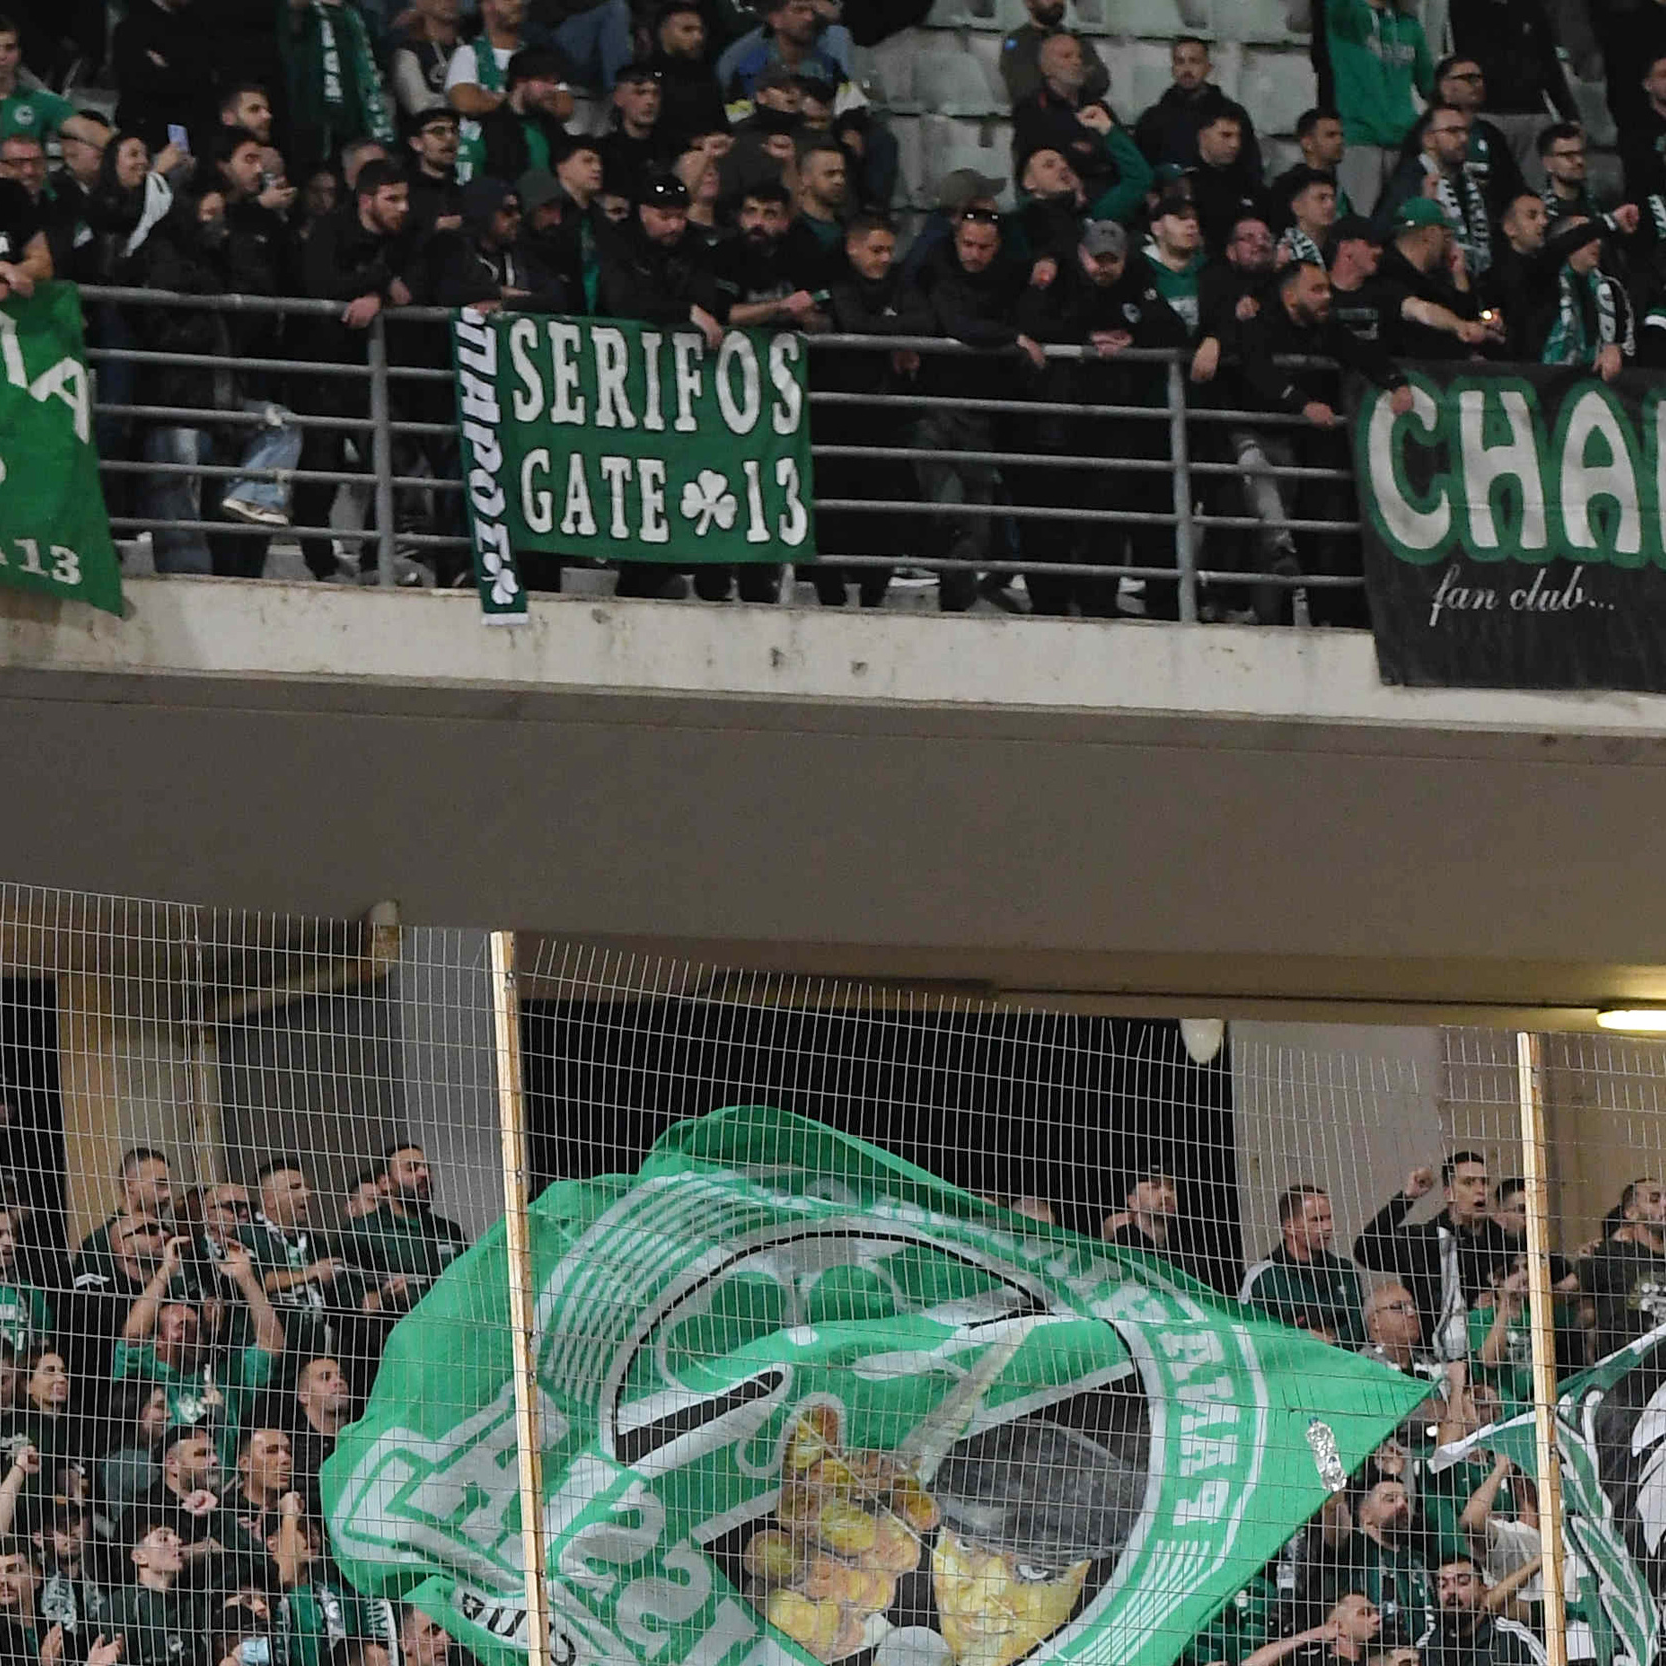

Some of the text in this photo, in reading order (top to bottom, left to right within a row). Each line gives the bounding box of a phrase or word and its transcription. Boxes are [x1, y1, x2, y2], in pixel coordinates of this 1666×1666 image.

[509, 318, 802, 434] SERIFOS
[520, 448, 808, 546] GATE 13
[14, 538, 83, 585] 13
[1429, 564, 1499, 627] fan
